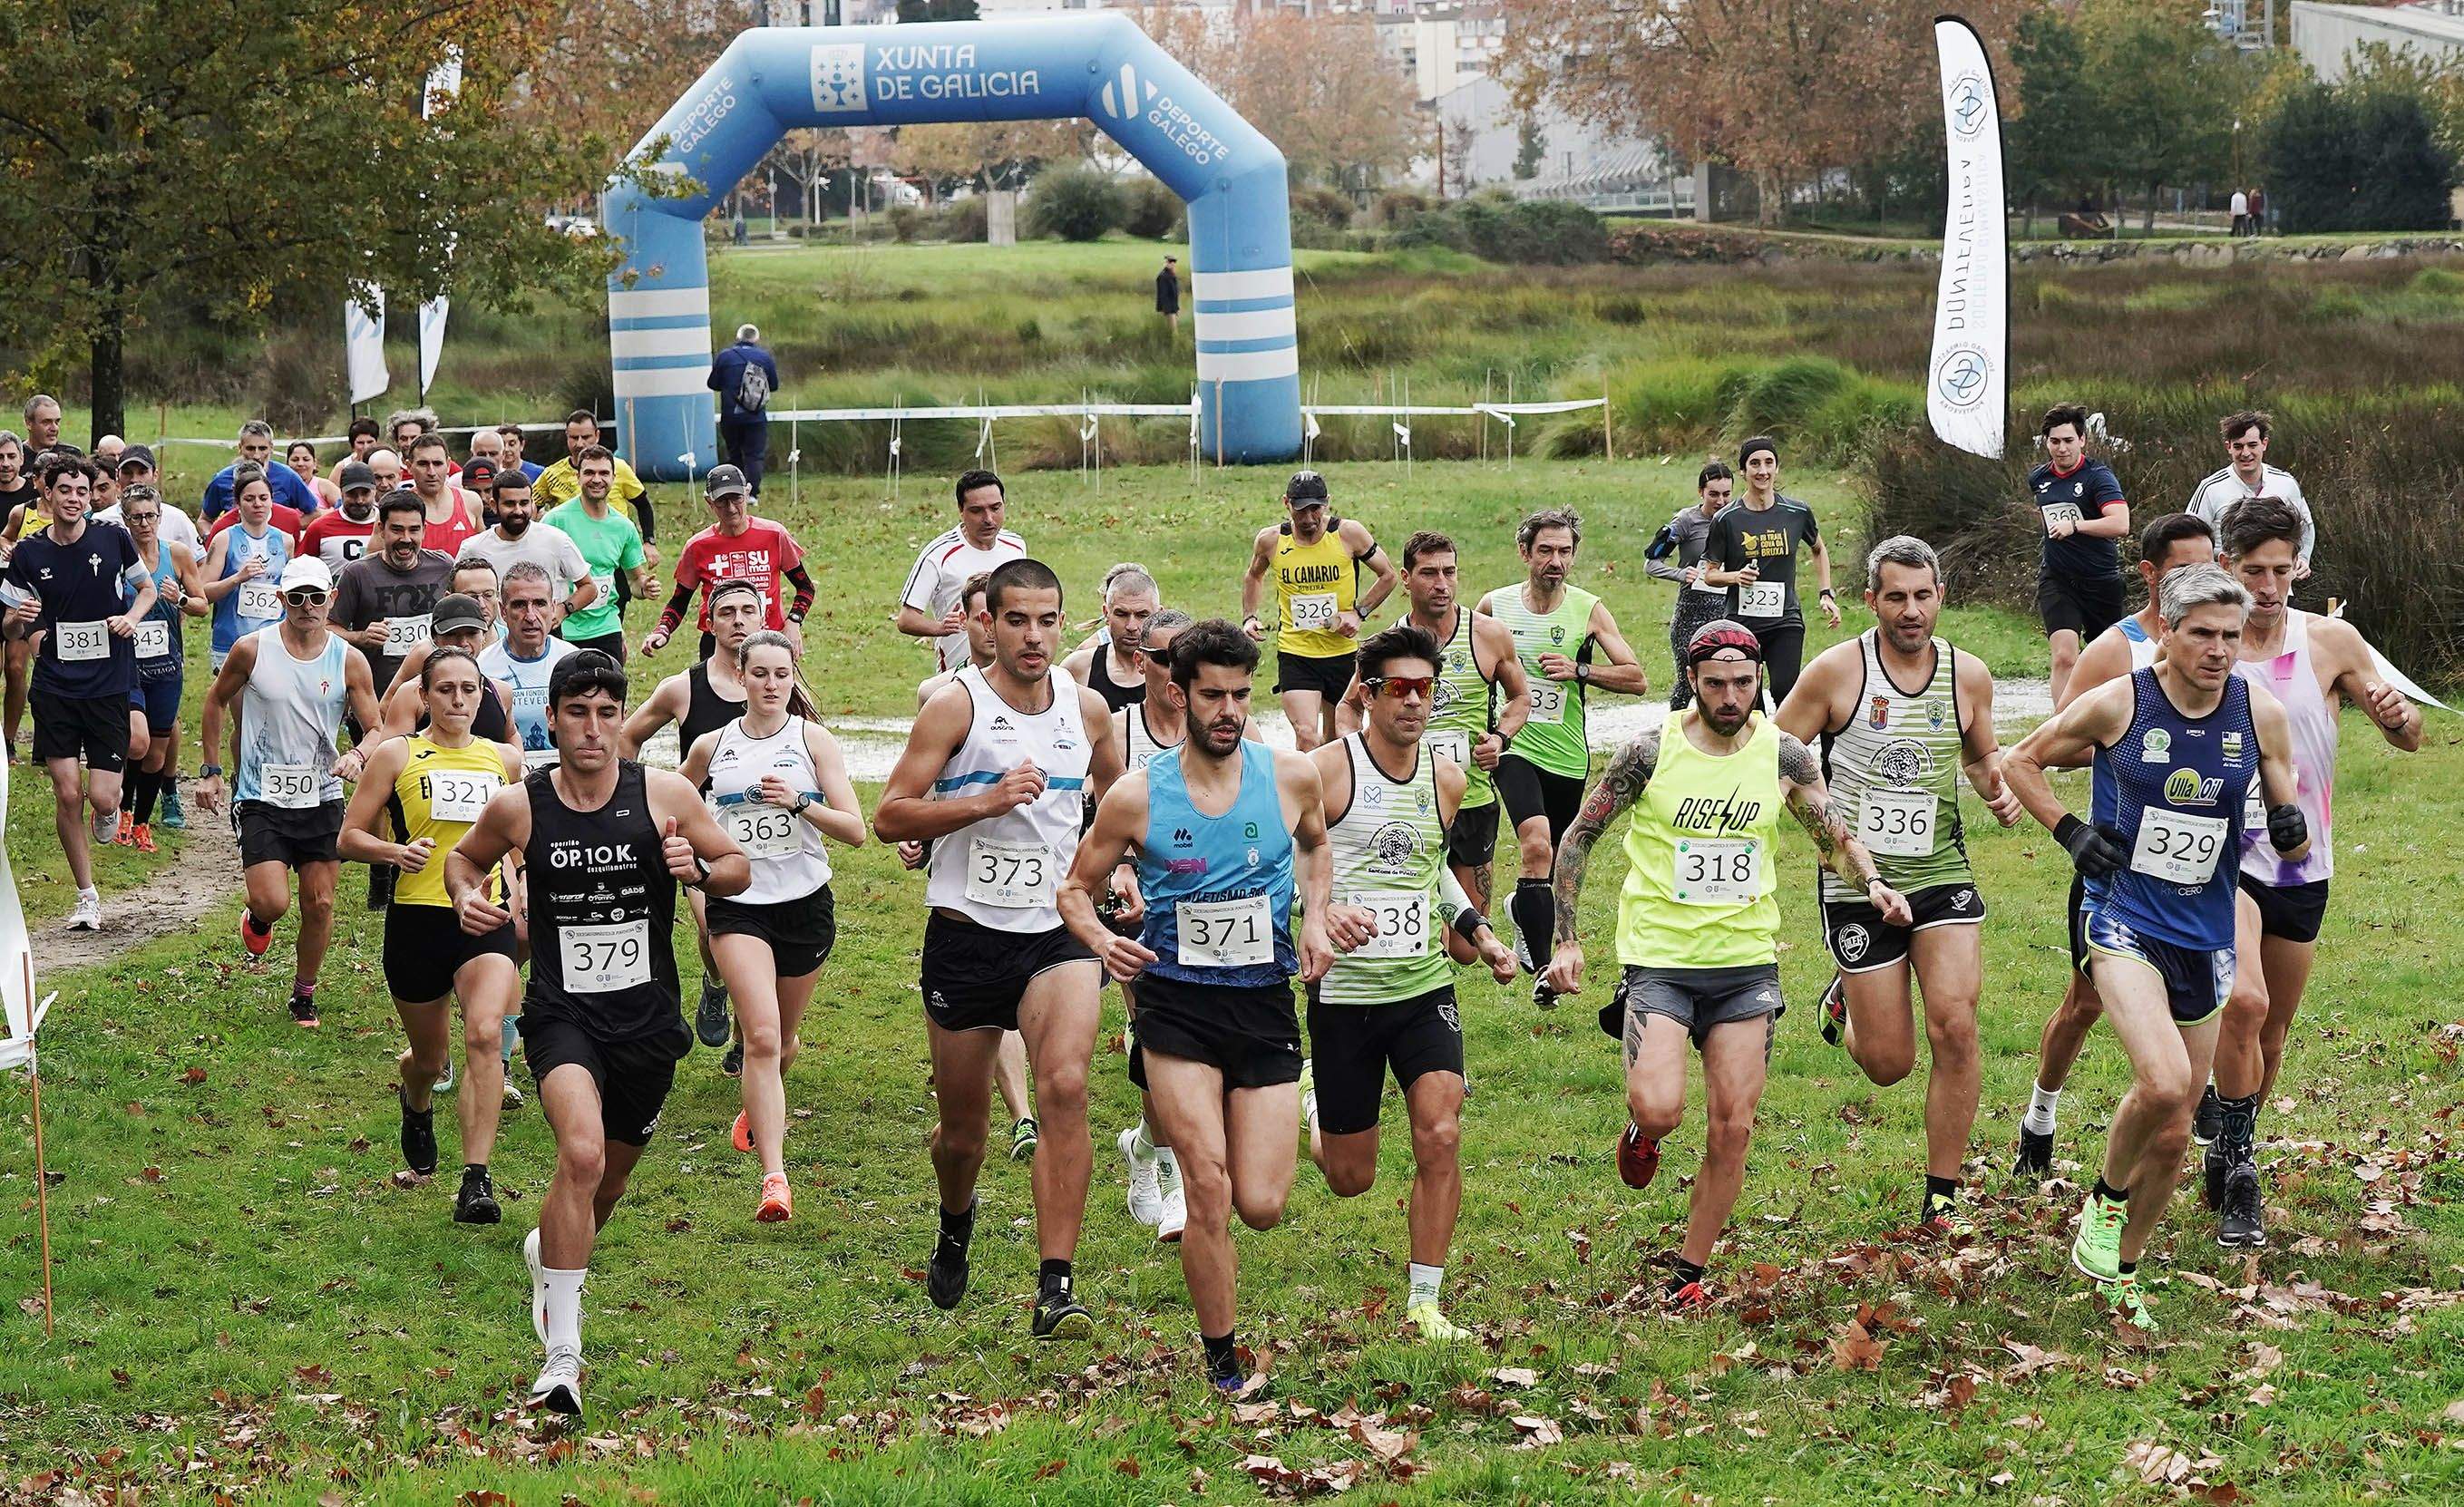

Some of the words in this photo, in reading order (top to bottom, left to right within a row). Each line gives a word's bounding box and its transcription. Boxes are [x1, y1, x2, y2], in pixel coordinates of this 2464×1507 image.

[876, 44, 976, 71] XUNTA
[876, 75, 914, 101] DE
[920, 70, 1040, 100] GALICIA
[669, 76, 734, 144] DEPORTE
[680, 94, 736, 153] GALEGO
[1147, 110, 1210, 165] GALEGO
[1157, 96, 1230, 160] DEPORTE
[747, 550, 769, 565] SU
[1761, 548, 1784, 557] BRUXA
[1281, 568, 1291, 584] EL
[1294, 565, 1340, 584] CANARIO
[244, 591, 278, 609] 362
[375, 583, 440, 617] FOX
[1297, 601, 1332, 619] 326
[1745, 590, 1778, 606] 323
[63, 630, 102, 649] 381
[390, 624, 428, 644] 330
[138, 665, 176, 676] ANTIAGO
[1531, 689, 1560, 710] 33
[268, 775, 313, 795] 350
[442, 780, 489, 804] 321
[2169, 778, 2194, 798] Ulla
[2199, 778, 2223, 799] Oil
[737, 813, 792, 842] 363
[1672, 798, 1725, 829] RISE
[1728, 801, 1760, 831] UP
[1867, 805, 1927, 835] 336
[2147, 826, 2216, 863] 329
[979, 855, 1043, 887] 373
[1685, 854, 1750, 882] 318
[2177, 885, 2203, 897] CERO
[1190, 915, 1260, 946] 371
[1364, 907, 1421, 936] 38
[574, 938, 639, 972] 379
